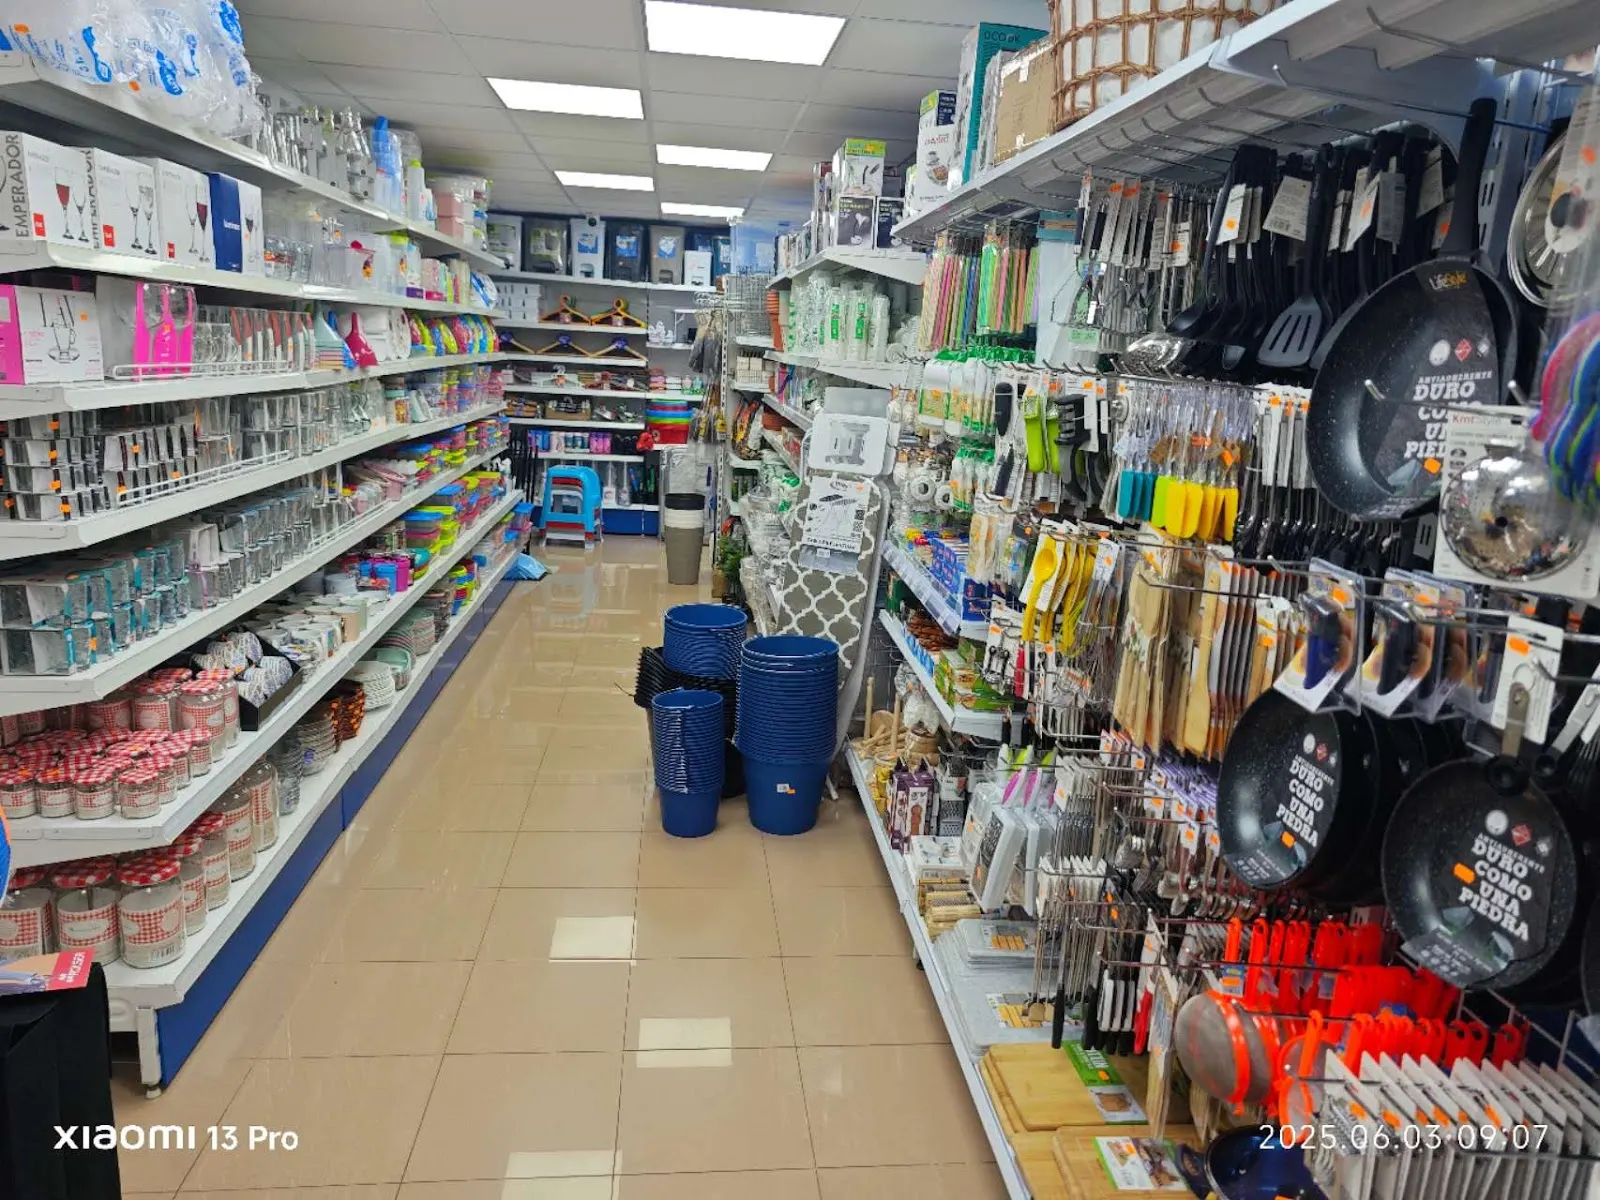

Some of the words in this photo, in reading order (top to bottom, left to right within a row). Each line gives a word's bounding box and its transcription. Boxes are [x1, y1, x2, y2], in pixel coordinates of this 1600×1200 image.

[6, 134, 30, 238] EMPERADOR
[1412, 381, 1475, 401] DURO
[1289, 760, 1323, 792] DURO
[1289, 779, 1324, 812] COMO
[1276, 803, 1319, 848] PIEDRA
[1290, 796, 1315, 827] UNA
[1471, 838, 1528, 879] DURO
[1474, 859, 1533, 901] COMO
[1479, 879, 1521, 917] UNA
[1458, 886, 1530, 941] PIEDRA
